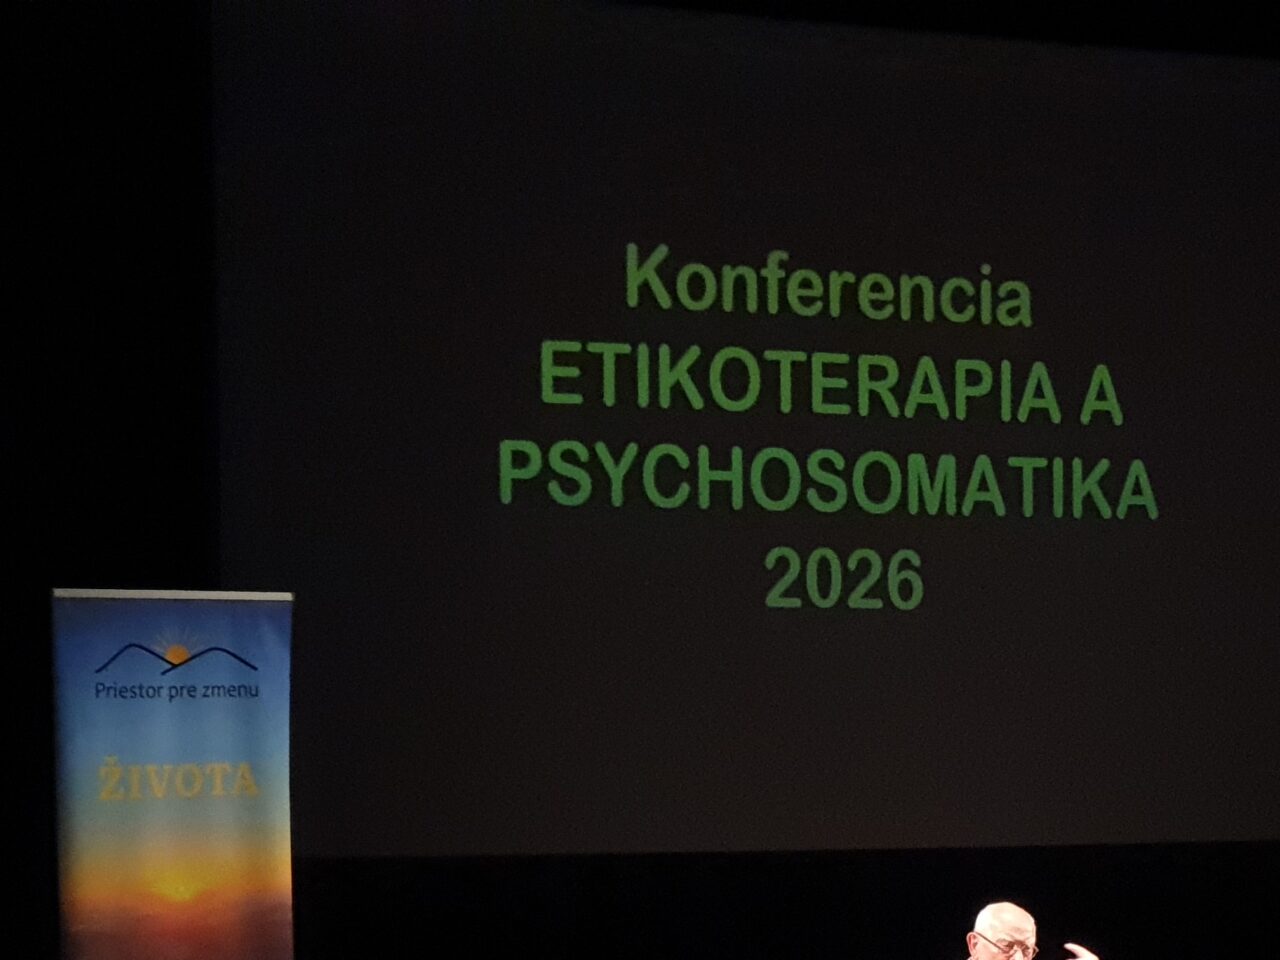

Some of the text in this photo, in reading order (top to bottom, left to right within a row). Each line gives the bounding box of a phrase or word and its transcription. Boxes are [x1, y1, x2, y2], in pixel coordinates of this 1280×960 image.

[626, 243, 1032, 328] Konferencia
[540, 340, 1124, 426] ETIKOTERAPIA A
[498, 438, 1159, 520] PSYCHOSOMATIKA
[764, 546, 924, 611] 2026
[94, 682, 259, 702] Priestor pre zmenu
[97, 754, 262, 801] ŽIVOTA
